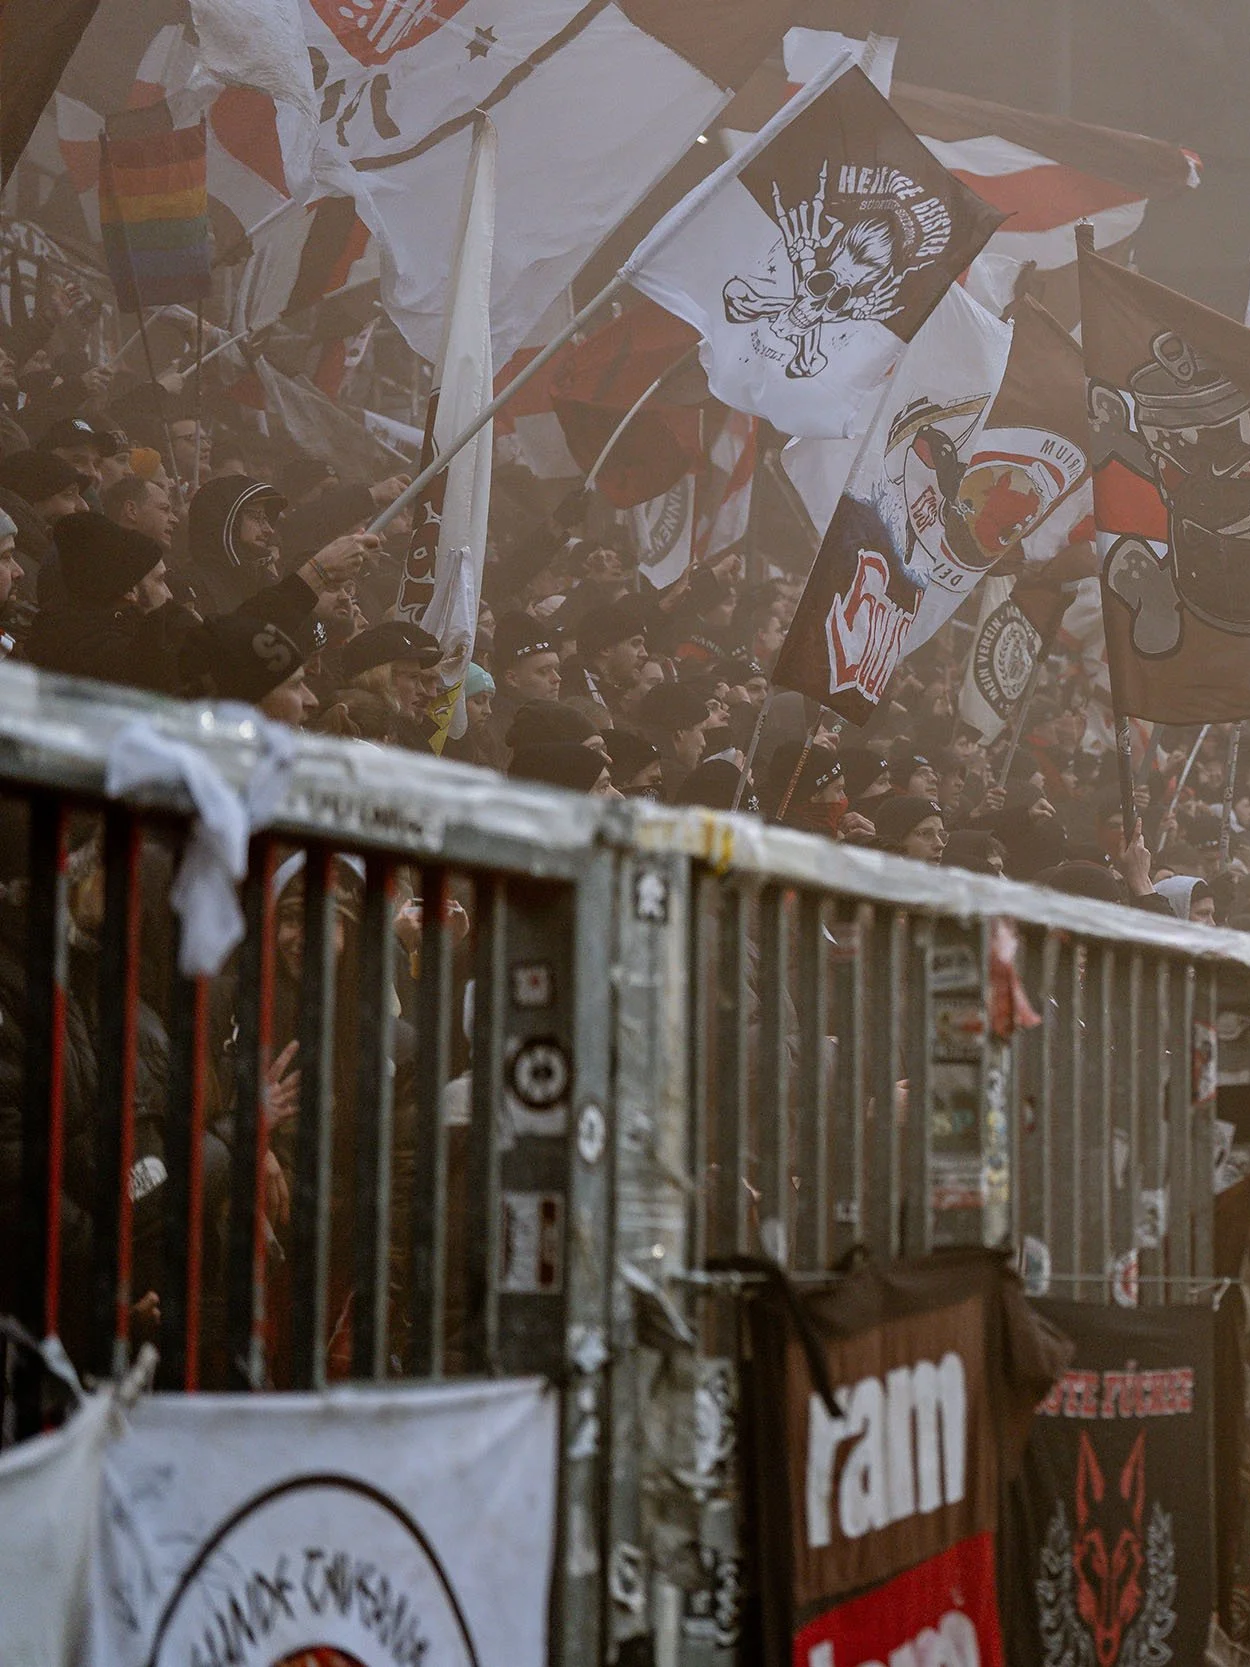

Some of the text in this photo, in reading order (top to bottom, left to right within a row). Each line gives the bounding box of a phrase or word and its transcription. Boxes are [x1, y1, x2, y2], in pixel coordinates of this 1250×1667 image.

[838, 165, 925, 201] HEILIGE
[911, 197, 952, 257] GEISTER
[976, 616, 1003, 700] MEIN VEREIN
